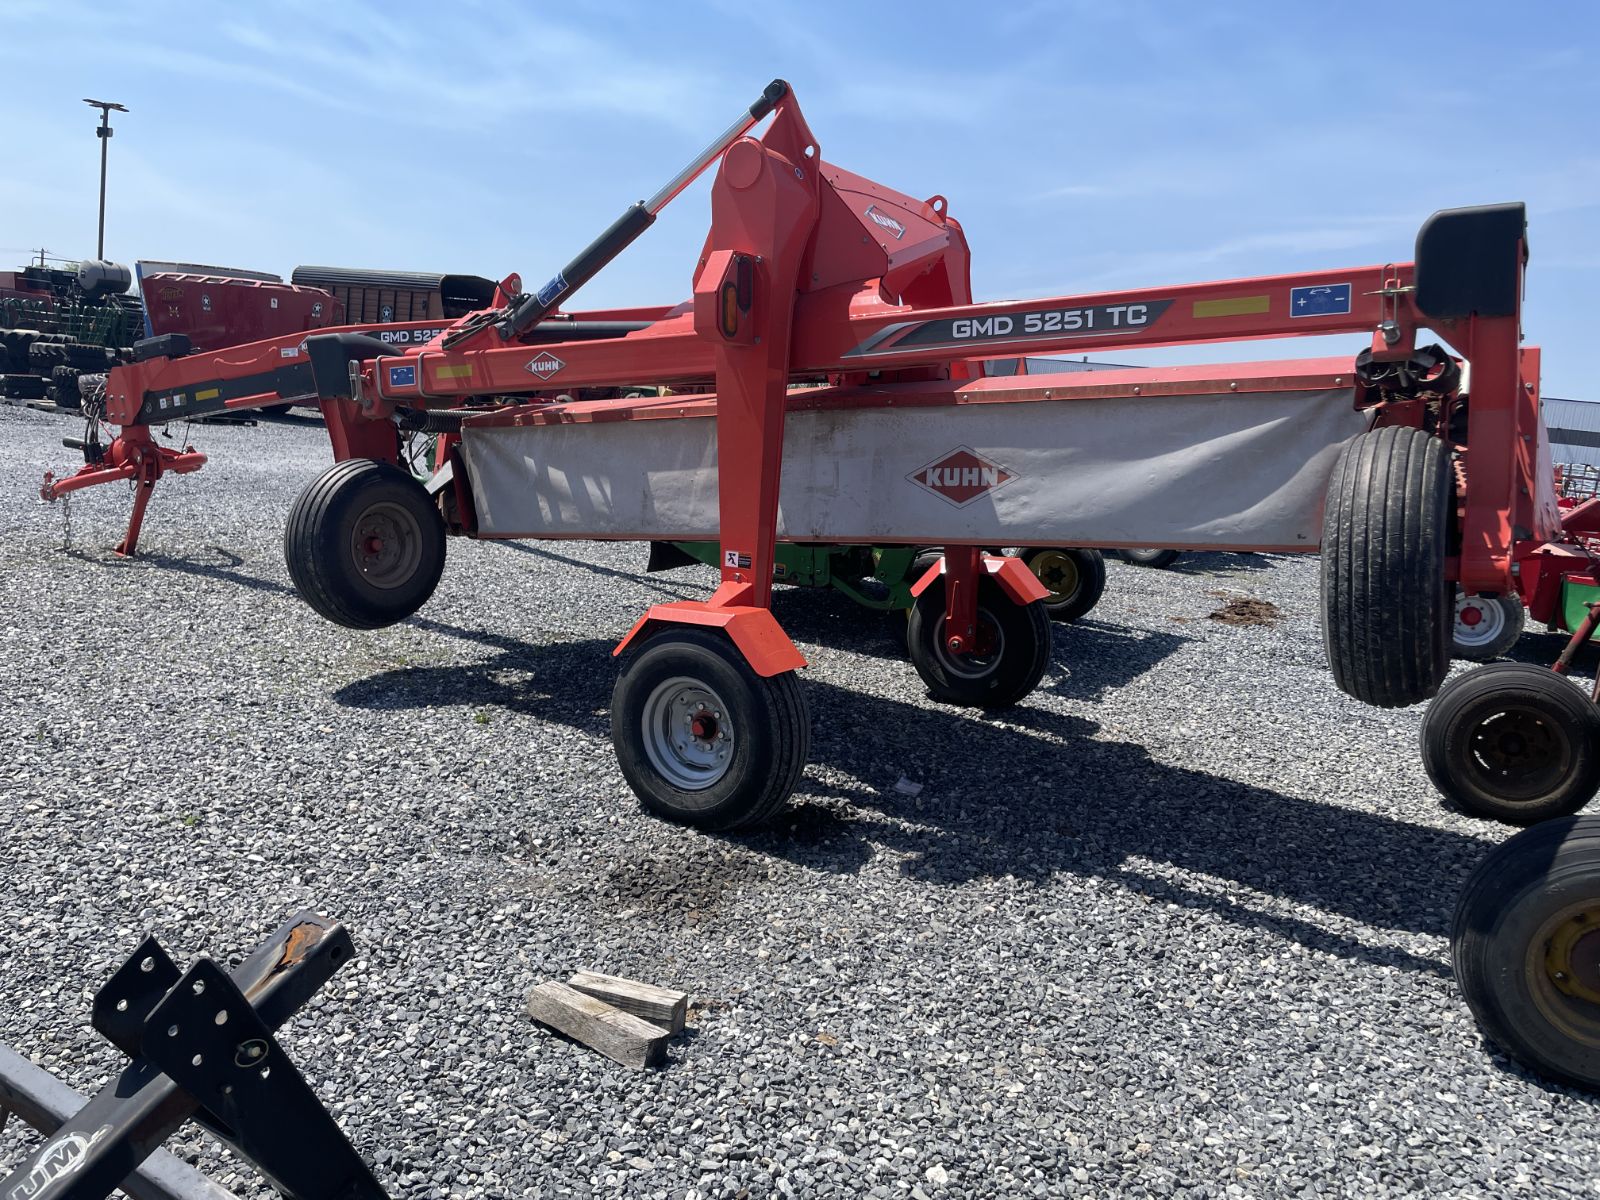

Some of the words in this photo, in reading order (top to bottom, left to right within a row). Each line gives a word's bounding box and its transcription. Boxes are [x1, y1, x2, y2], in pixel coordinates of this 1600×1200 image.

[952, 316, 1014, 339] GMD
[1024, 309, 1094, 333] 5251
[1106, 305, 1148, 326] TC
[380, 331, 410, 343] GMD
[413, 328, 445, 342] 525
[531, 360, 559, 372] KUHN
[925, 467, 999, 487] KUHN
